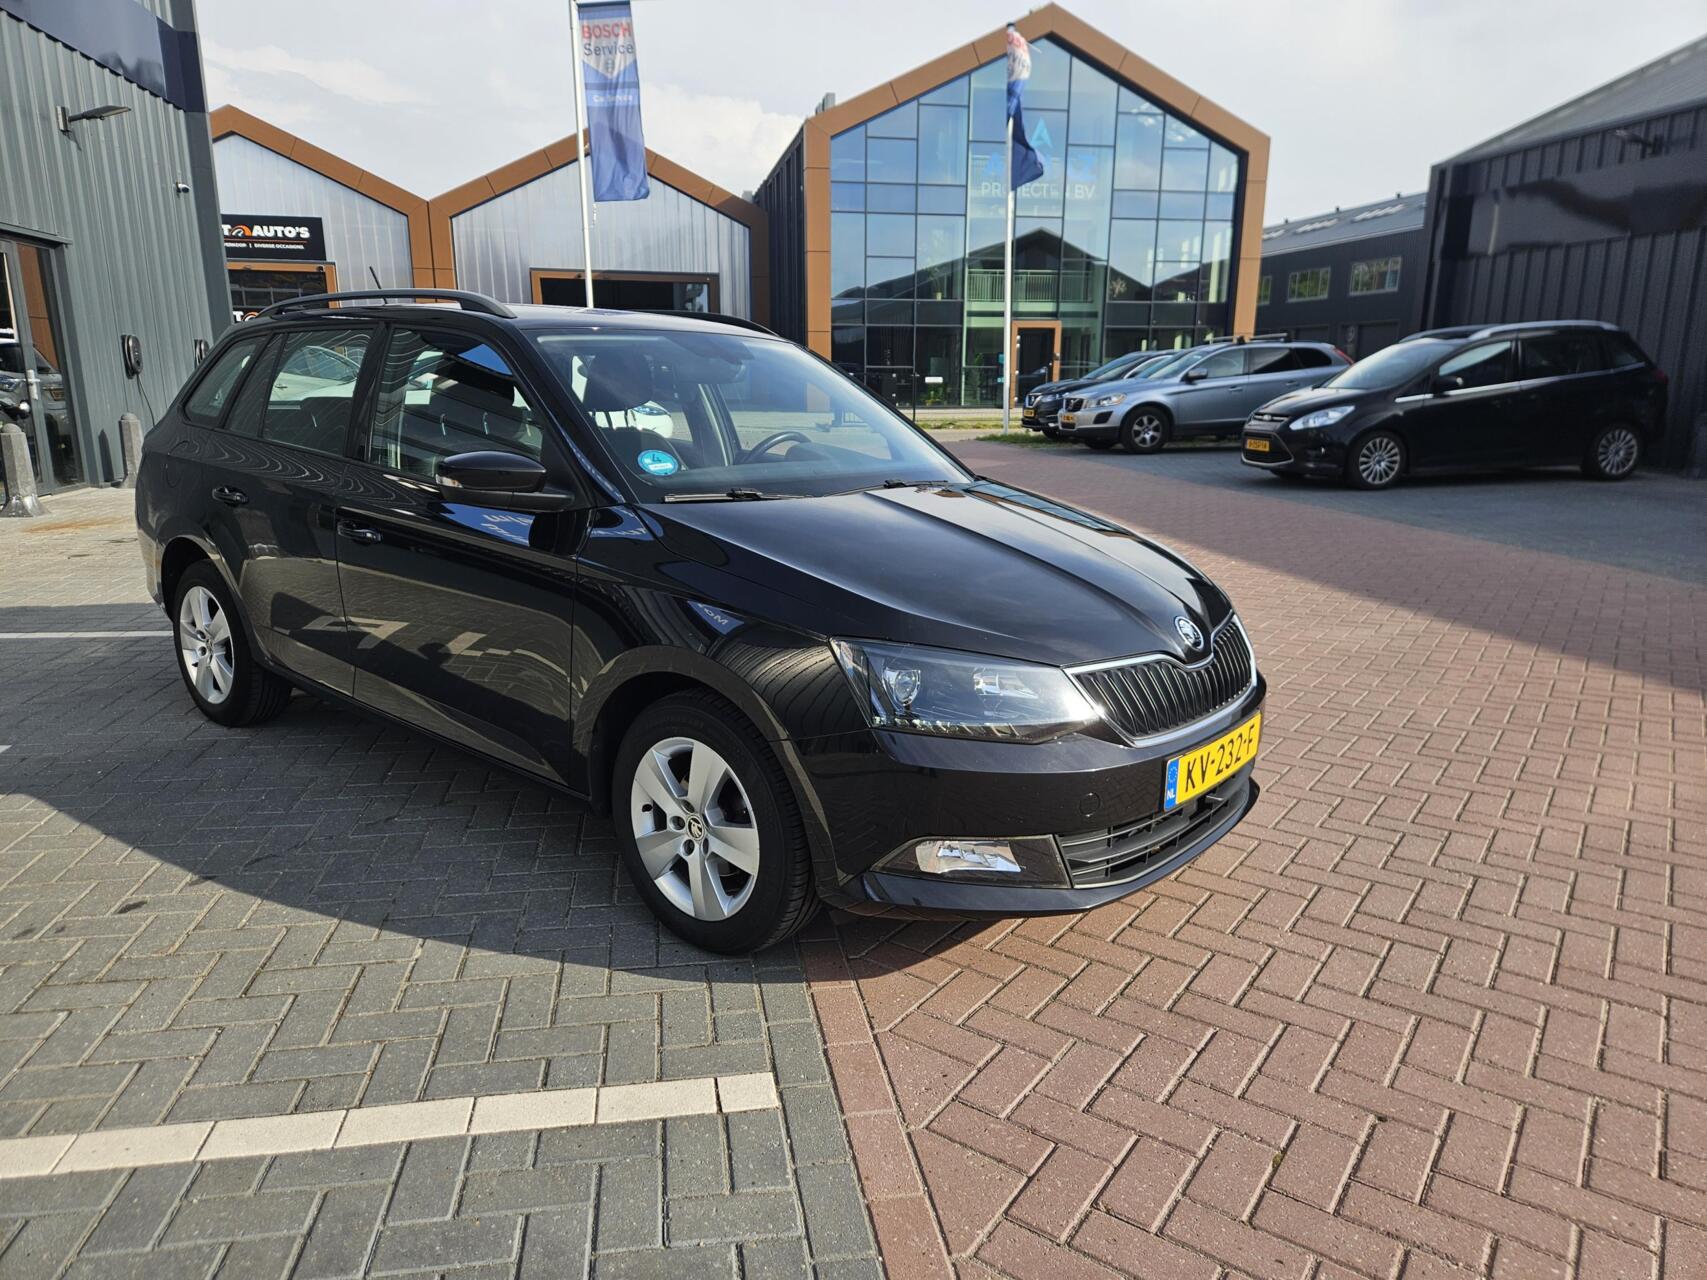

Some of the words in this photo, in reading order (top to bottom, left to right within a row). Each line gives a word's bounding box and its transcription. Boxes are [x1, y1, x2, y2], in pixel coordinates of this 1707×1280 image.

[582, 22, 632, 39] BOSCH
[584, 42, 634, 56] Service
[1074, 183, 1096, 200] BV
[252, 224, 310, 239] AUTO'S
[1184, 723, 1255, 793] KV-232-F
